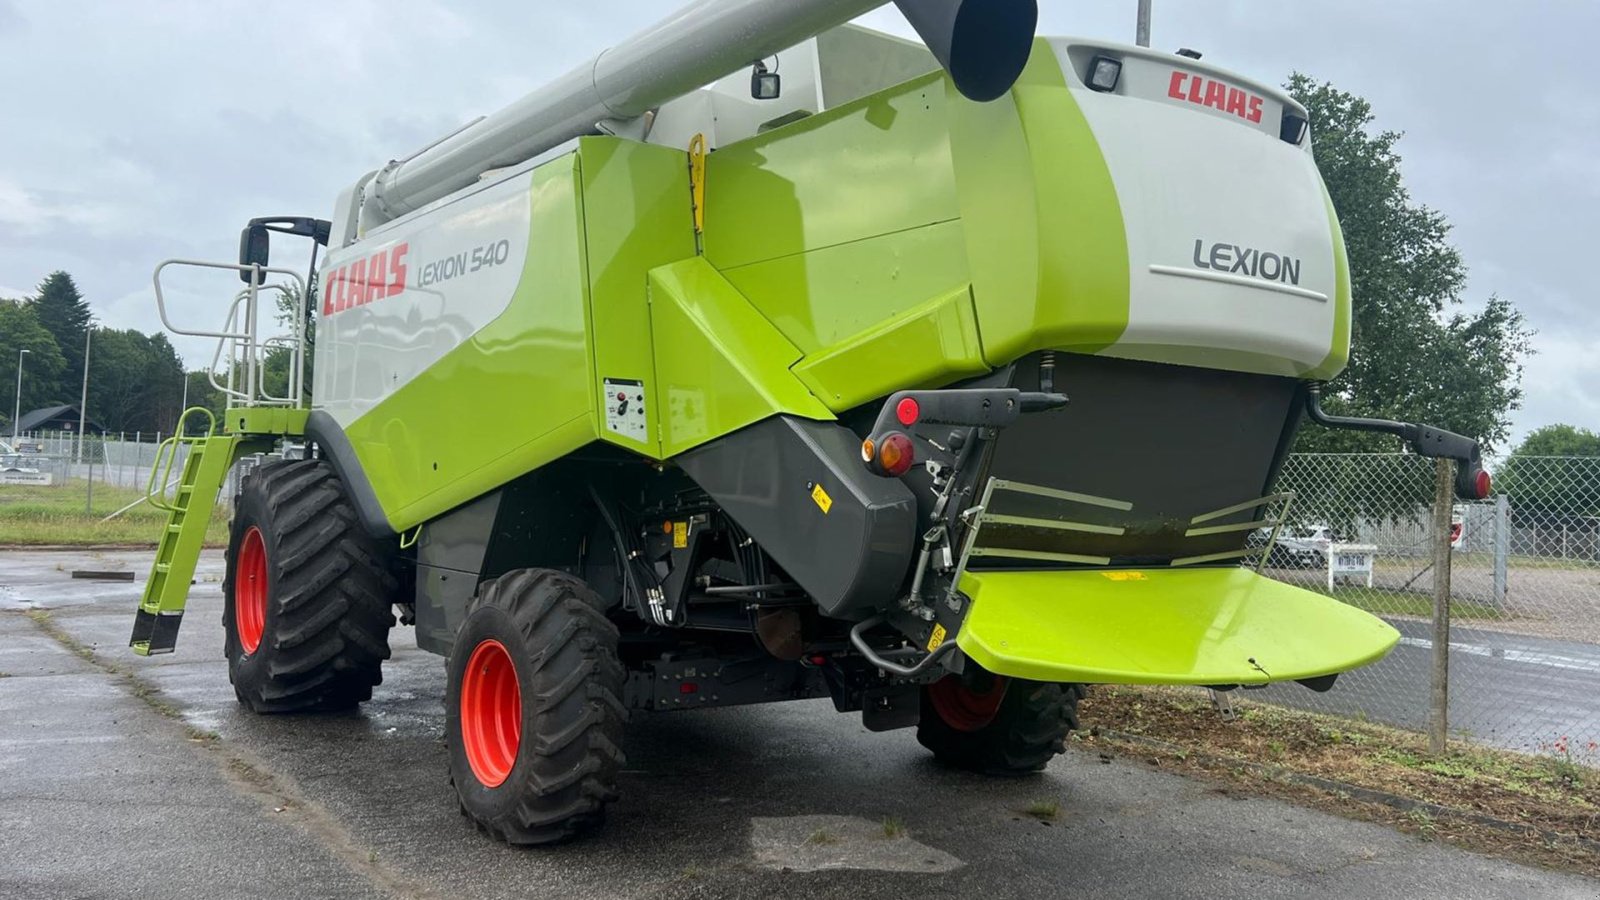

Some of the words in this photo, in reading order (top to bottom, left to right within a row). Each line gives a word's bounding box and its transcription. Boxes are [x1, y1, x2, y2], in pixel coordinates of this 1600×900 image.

[1168, 71, 1264, 124] CLAAS
[323, 242, 409, 317] CLAAS
[417, 251, 468, 288] LEXION
[470, 239, 510, 273] 540
[1193, 239, 1300, 285] LEXION
